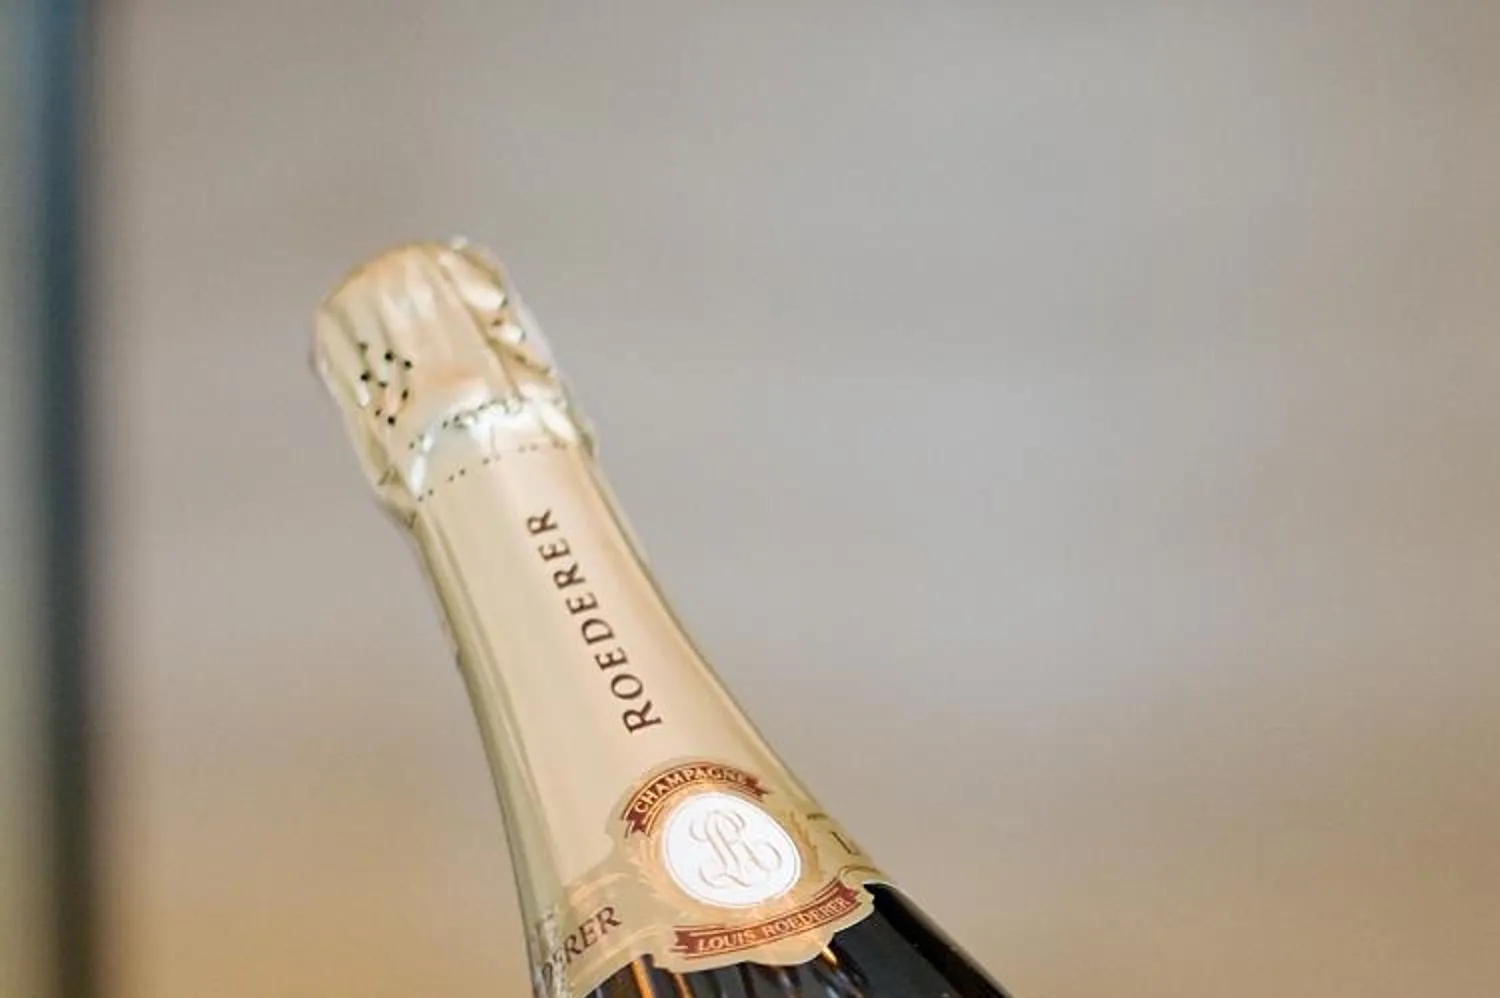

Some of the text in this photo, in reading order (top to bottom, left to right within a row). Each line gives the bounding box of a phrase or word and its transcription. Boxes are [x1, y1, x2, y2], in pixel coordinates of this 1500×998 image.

[526, 508, 663, 734] ROEDERER
[697, 896, 851, 951] LOUIS ROEDERER
